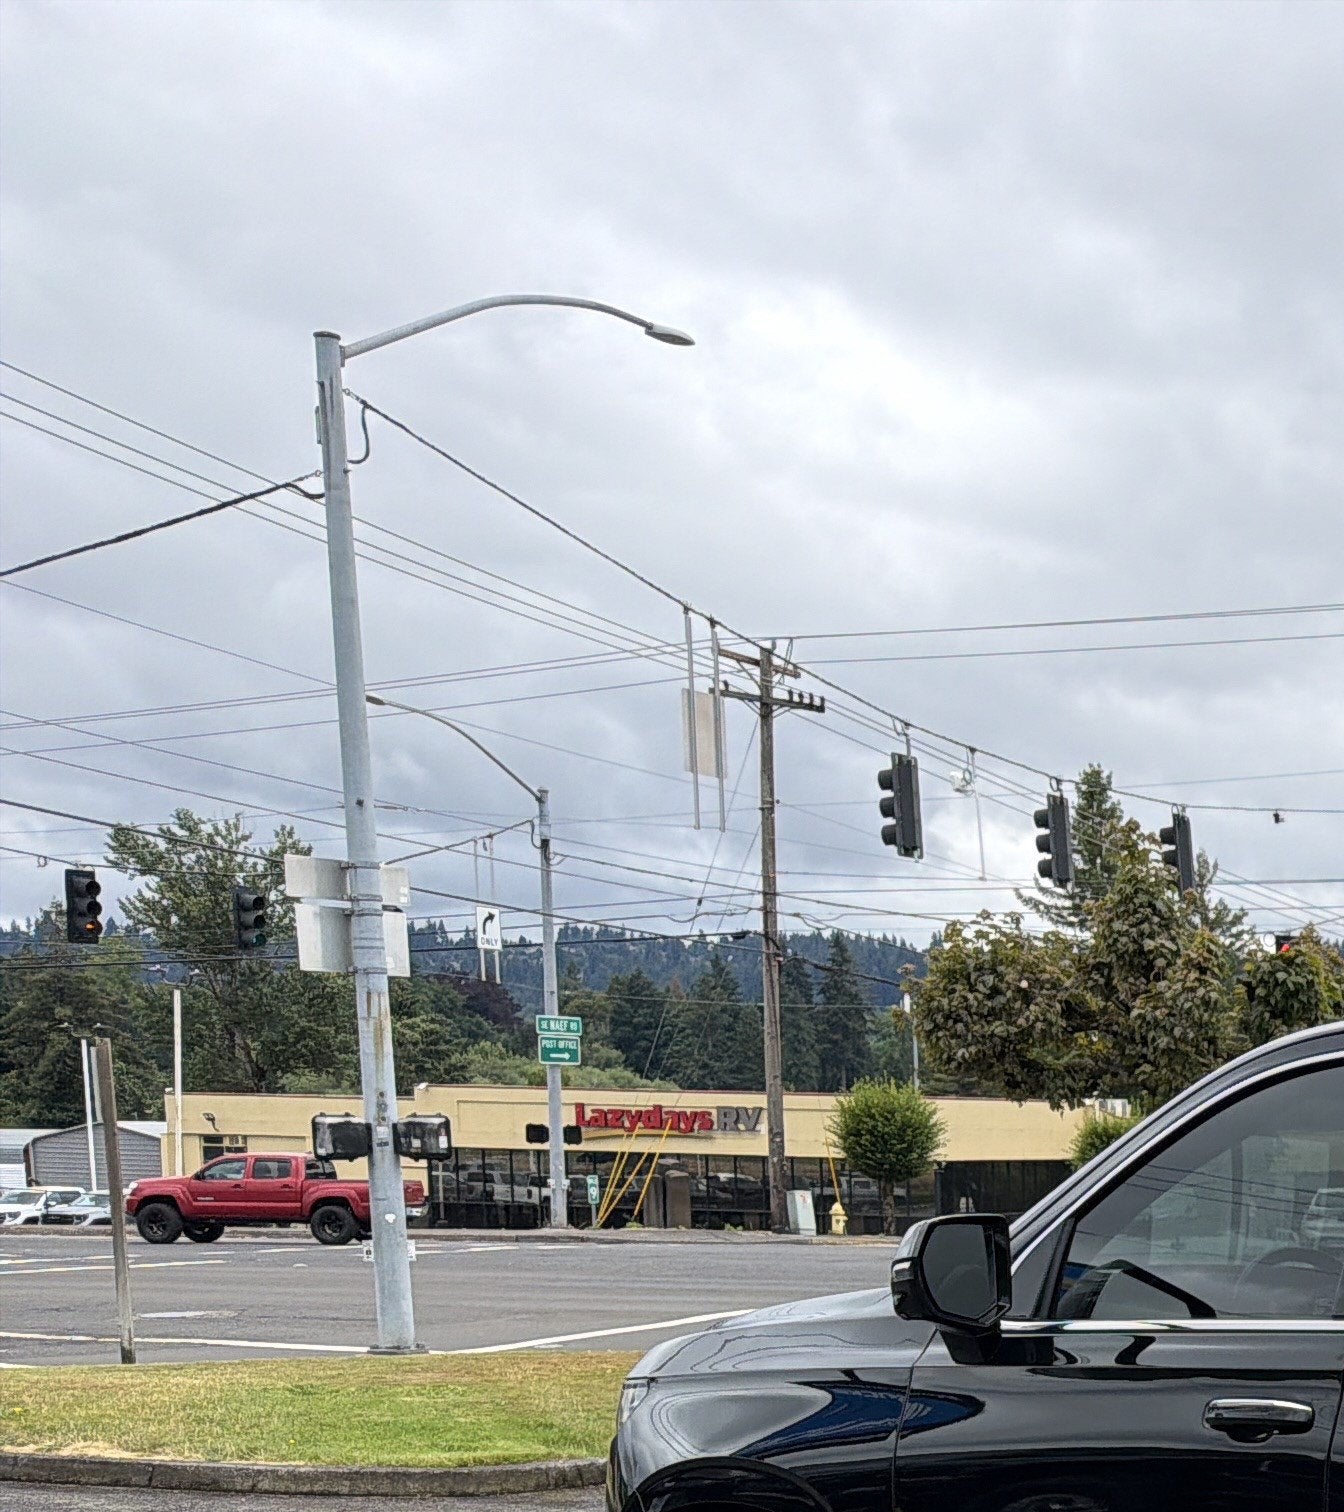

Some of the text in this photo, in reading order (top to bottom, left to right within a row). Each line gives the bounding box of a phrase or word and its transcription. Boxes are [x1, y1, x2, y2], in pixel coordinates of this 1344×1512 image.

[481, 937, 499, 946] ONLY
[541, 1039, 578, 1049] POST OFFICE
[576, 1103, 762, 1133] Lazydays RV
